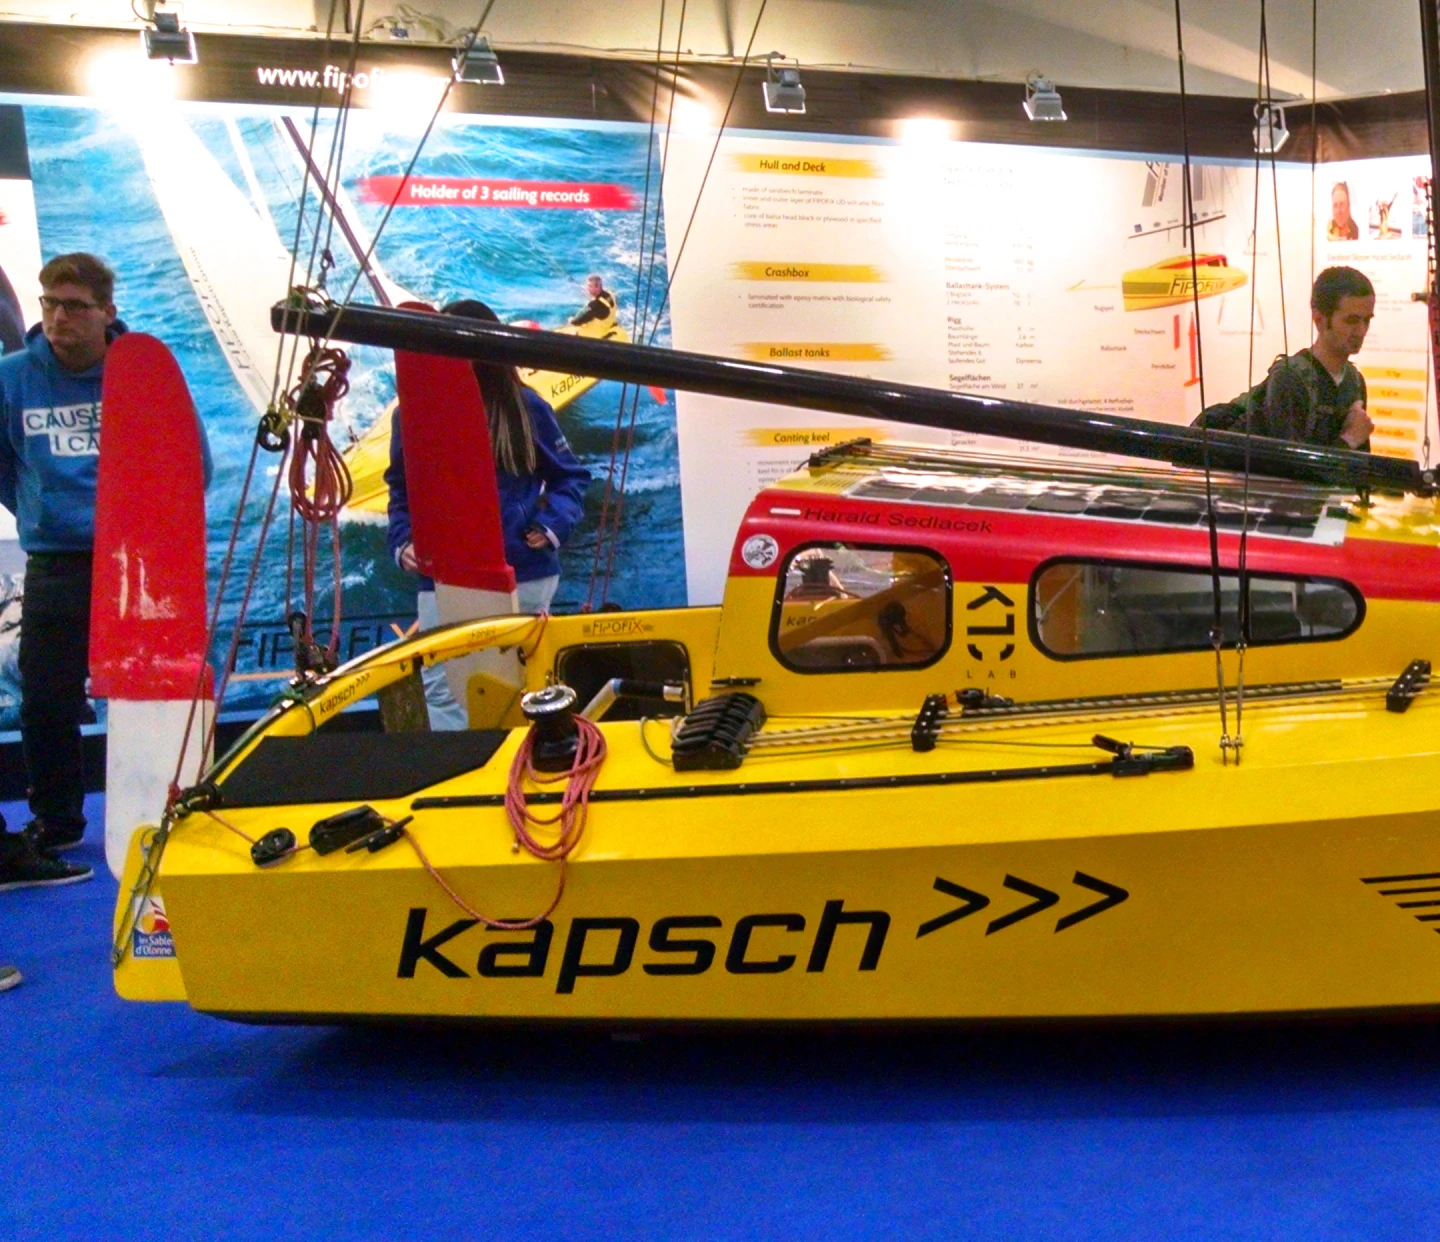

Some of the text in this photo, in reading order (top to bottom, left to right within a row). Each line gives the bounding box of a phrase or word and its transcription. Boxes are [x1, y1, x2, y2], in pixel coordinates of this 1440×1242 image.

[760, 159, 826, 172] Hull and Deck
[411, 184, 589, 205] Holder of 3 sailing records
[765, 267, 809, 277] Crashbox
[770, 347, 830, 358] Ballast tanks
[774, 432, 830, 444] Canting keel
[803, 507, 993, 533] Harald Sedlacek
[319, 685, 355, 716] kapsch
[397, 899, 891, 994] kapsch
